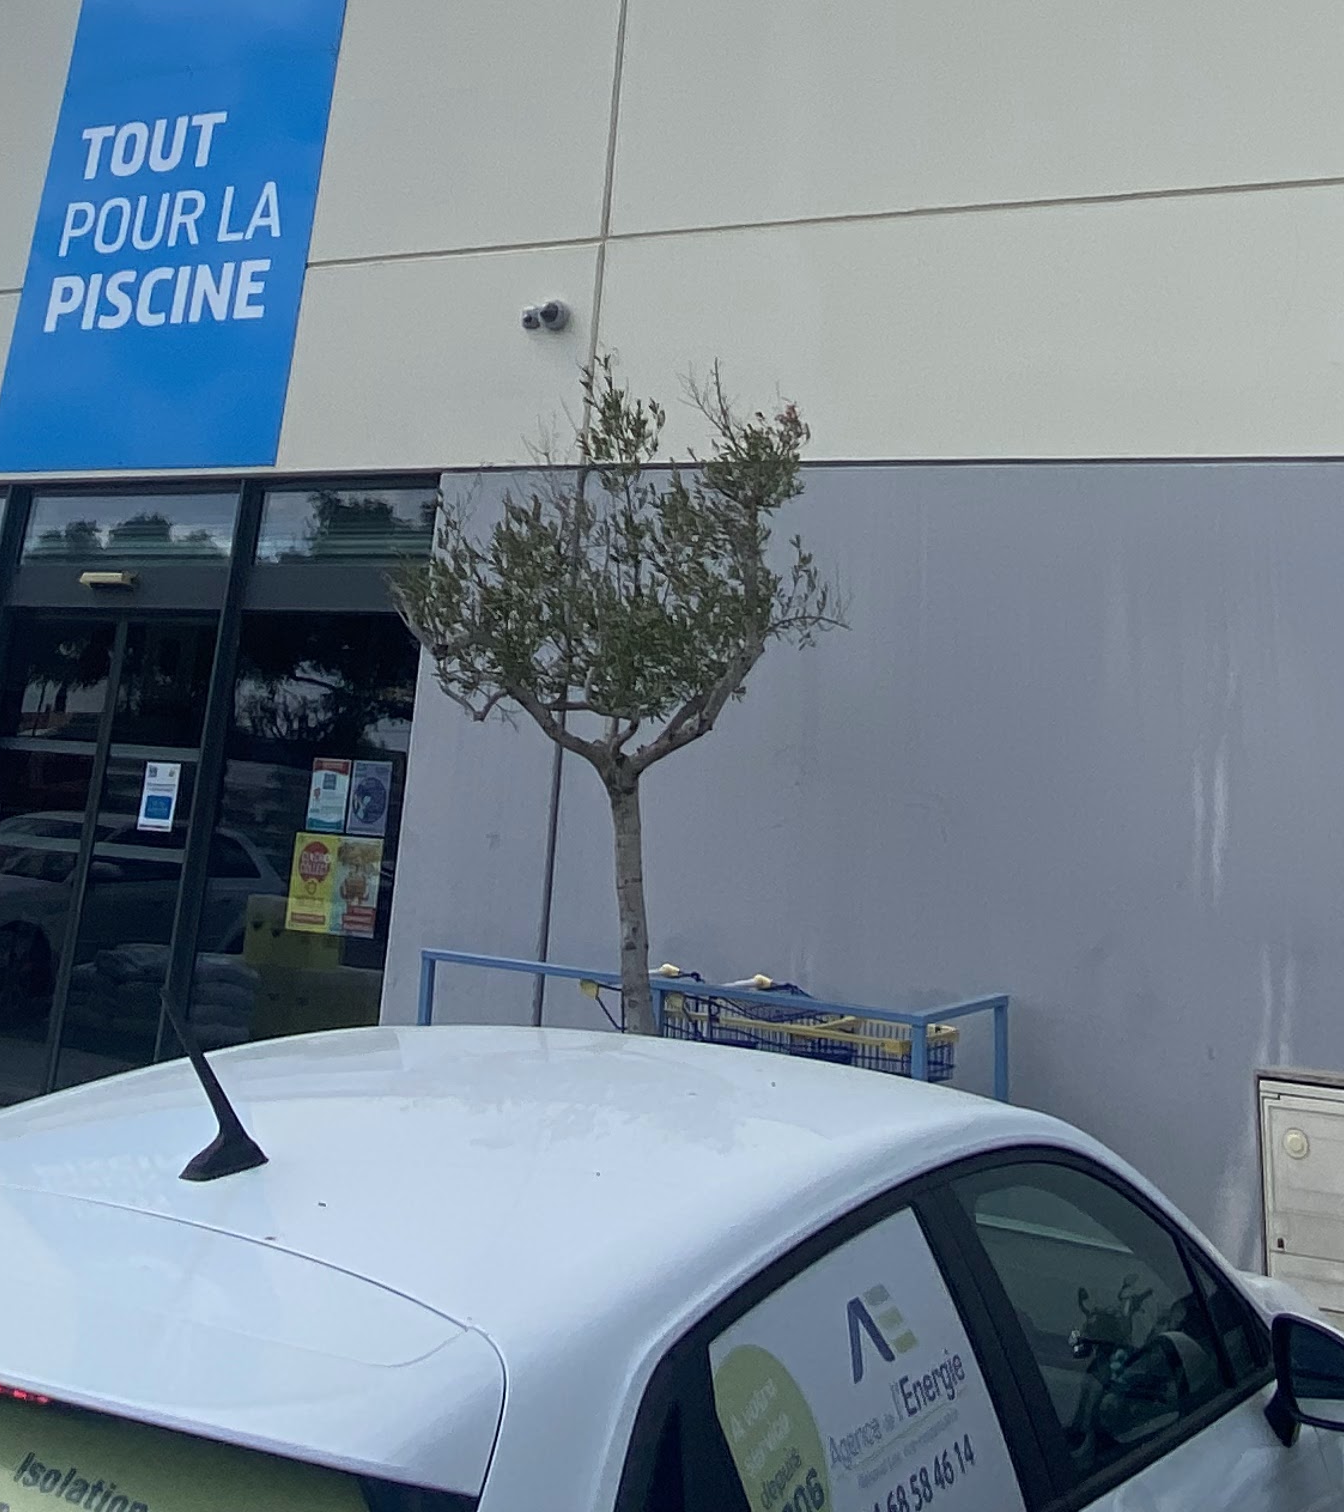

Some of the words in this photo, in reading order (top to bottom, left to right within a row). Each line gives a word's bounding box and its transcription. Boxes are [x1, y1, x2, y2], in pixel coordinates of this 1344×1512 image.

[82, 110, 228, 180] TOUT
[58, 189, 207, 258] POUR
[217, 181, 282, 243] LA
[43, 258, 272, 333] PISCINE
[761, 1447, 802, 1509] depuis
[828, 1417, 883, 1470] Agence
[910, 1467, 933, 1511] 58
[934, 1448, 954, 1489] 46
[954, 1433, 975, 1474] 14
